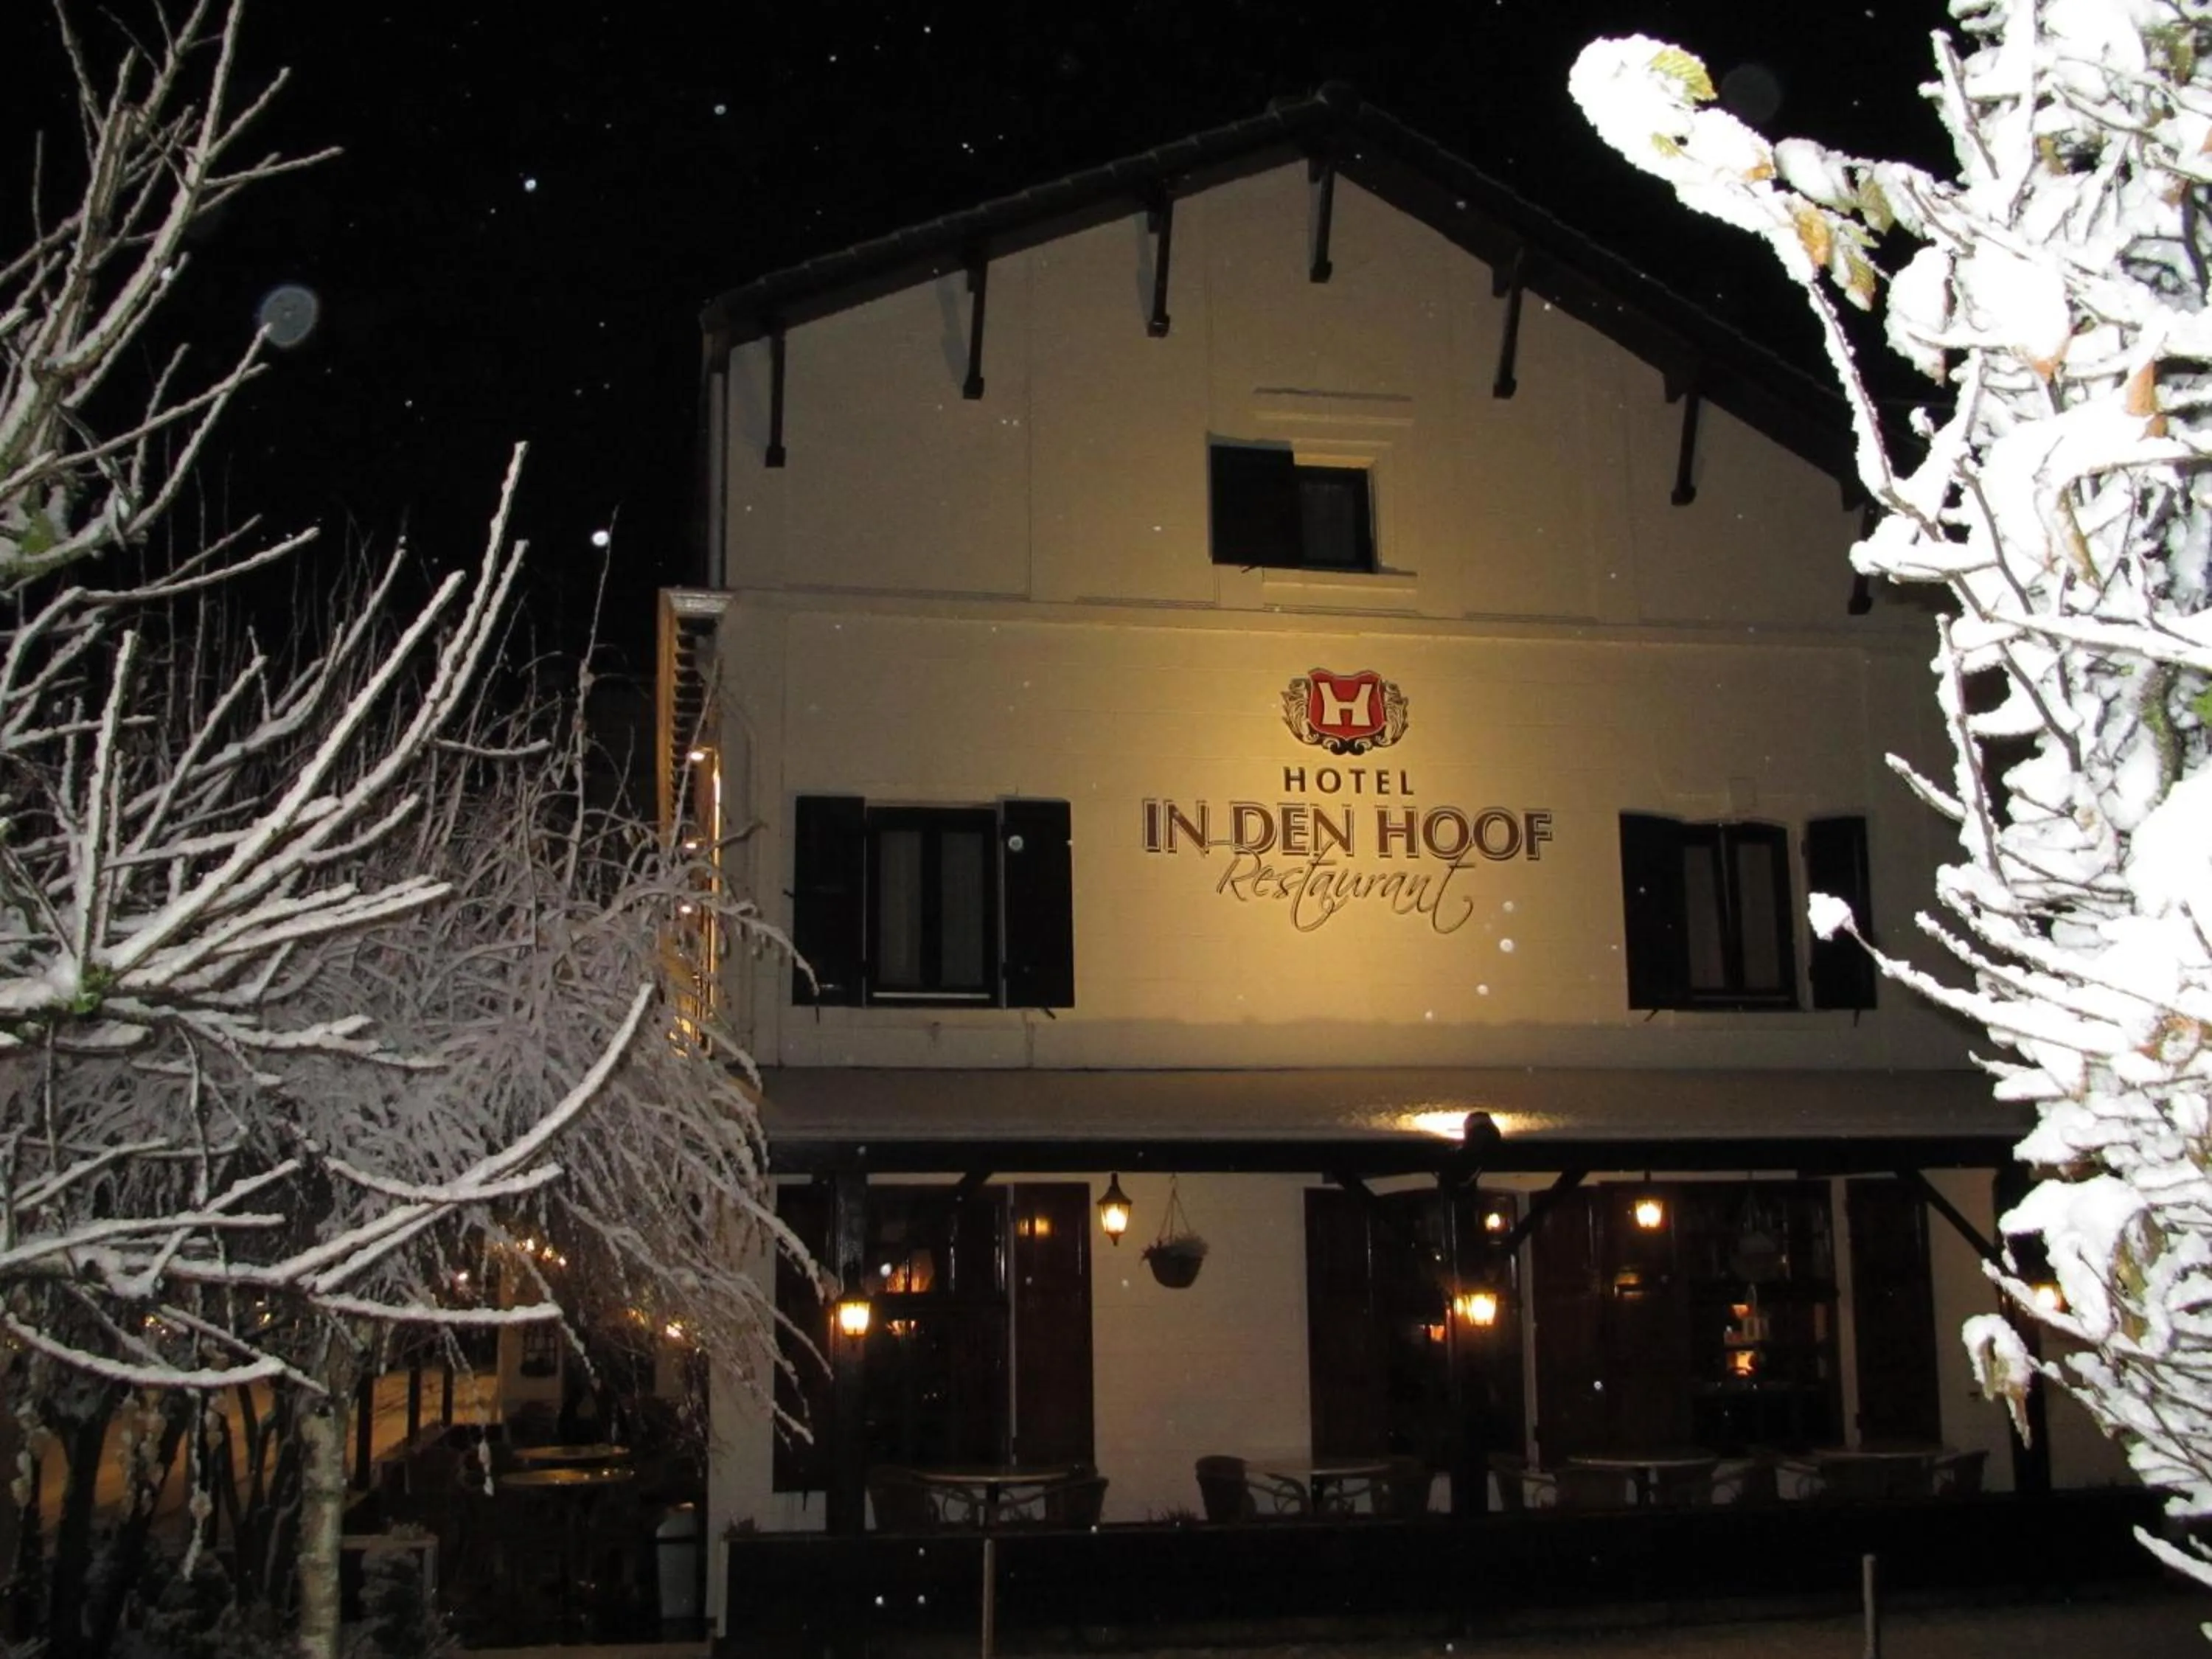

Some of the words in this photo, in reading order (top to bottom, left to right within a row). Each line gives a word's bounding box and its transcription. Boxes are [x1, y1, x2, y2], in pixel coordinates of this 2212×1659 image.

[1318, 681, 1371, 727] H
[1283, 766, 1415, 796] HOTEL
[1142, 798, 1209, 855] IN
[1229, 800, 1355, 858] DEN
[1375, 804, 1554, 861] HOOF
[1214, 841, 1475, 934] Restaurant
